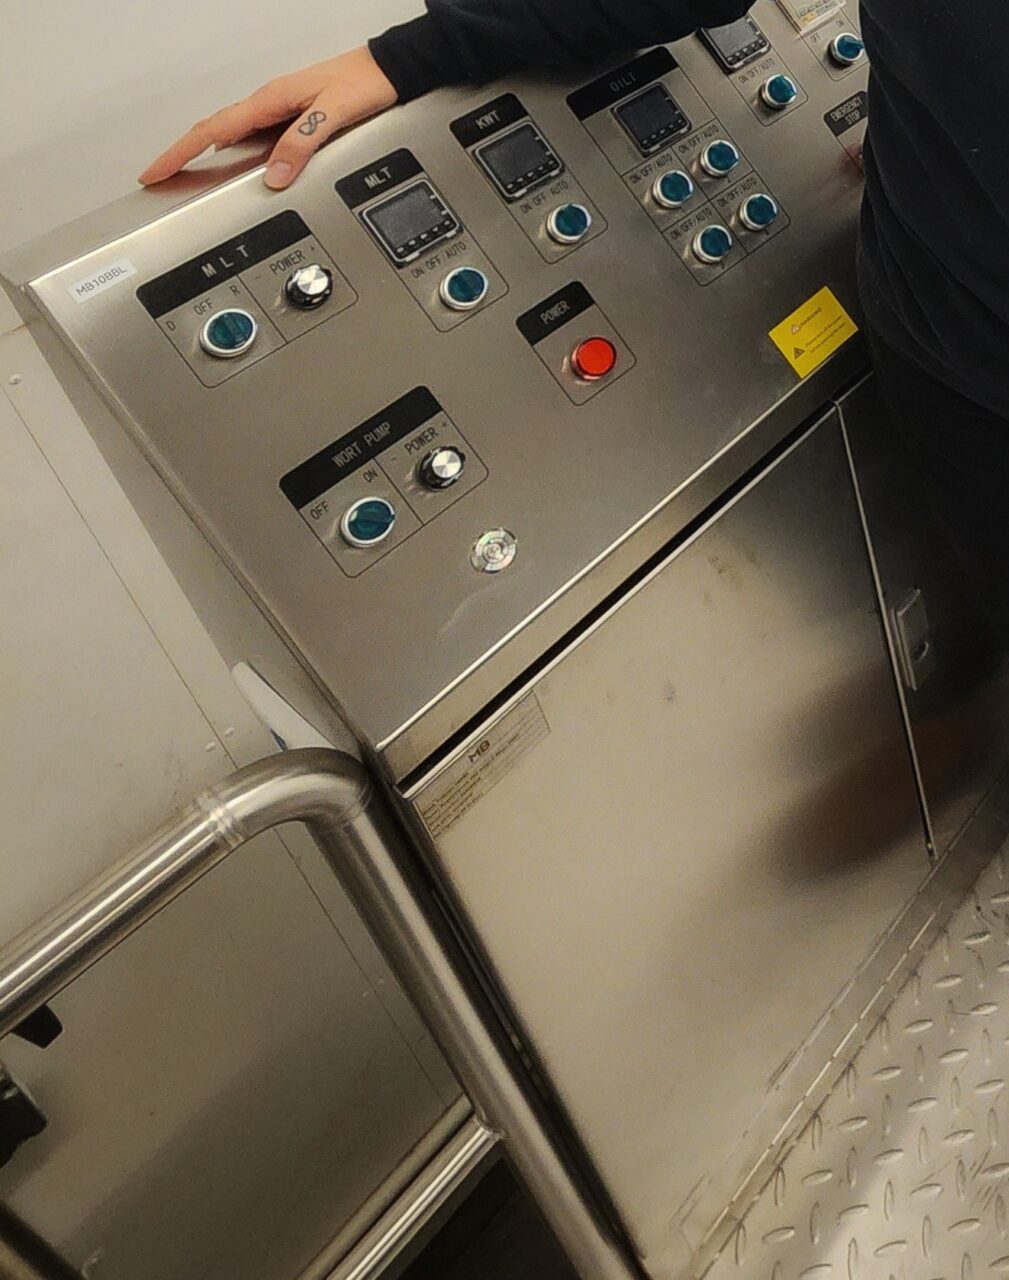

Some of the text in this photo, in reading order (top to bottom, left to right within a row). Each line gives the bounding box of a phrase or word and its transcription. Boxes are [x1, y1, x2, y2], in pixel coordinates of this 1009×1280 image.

[475, 109, 501, 130] KWT
[830, 95, 864, 123] EMERGENCY
[847, 110, 861, 126] STOP
[364, 167, 393, 189] MLT
[269, 250, 306, 276] POWER
[75, 265, 128, 297] MB10BBL
[193, 298, 214, 316] OFF
[229, 285, 241, 296] R
[540, 300, 570, 325] POWER
[331, 421, 392, 469] WORT PUMP
[404, 426, 439, 456] POWER
[310, 467, 379, 521] OFF ON
[467, 739, 491, 764] MB
